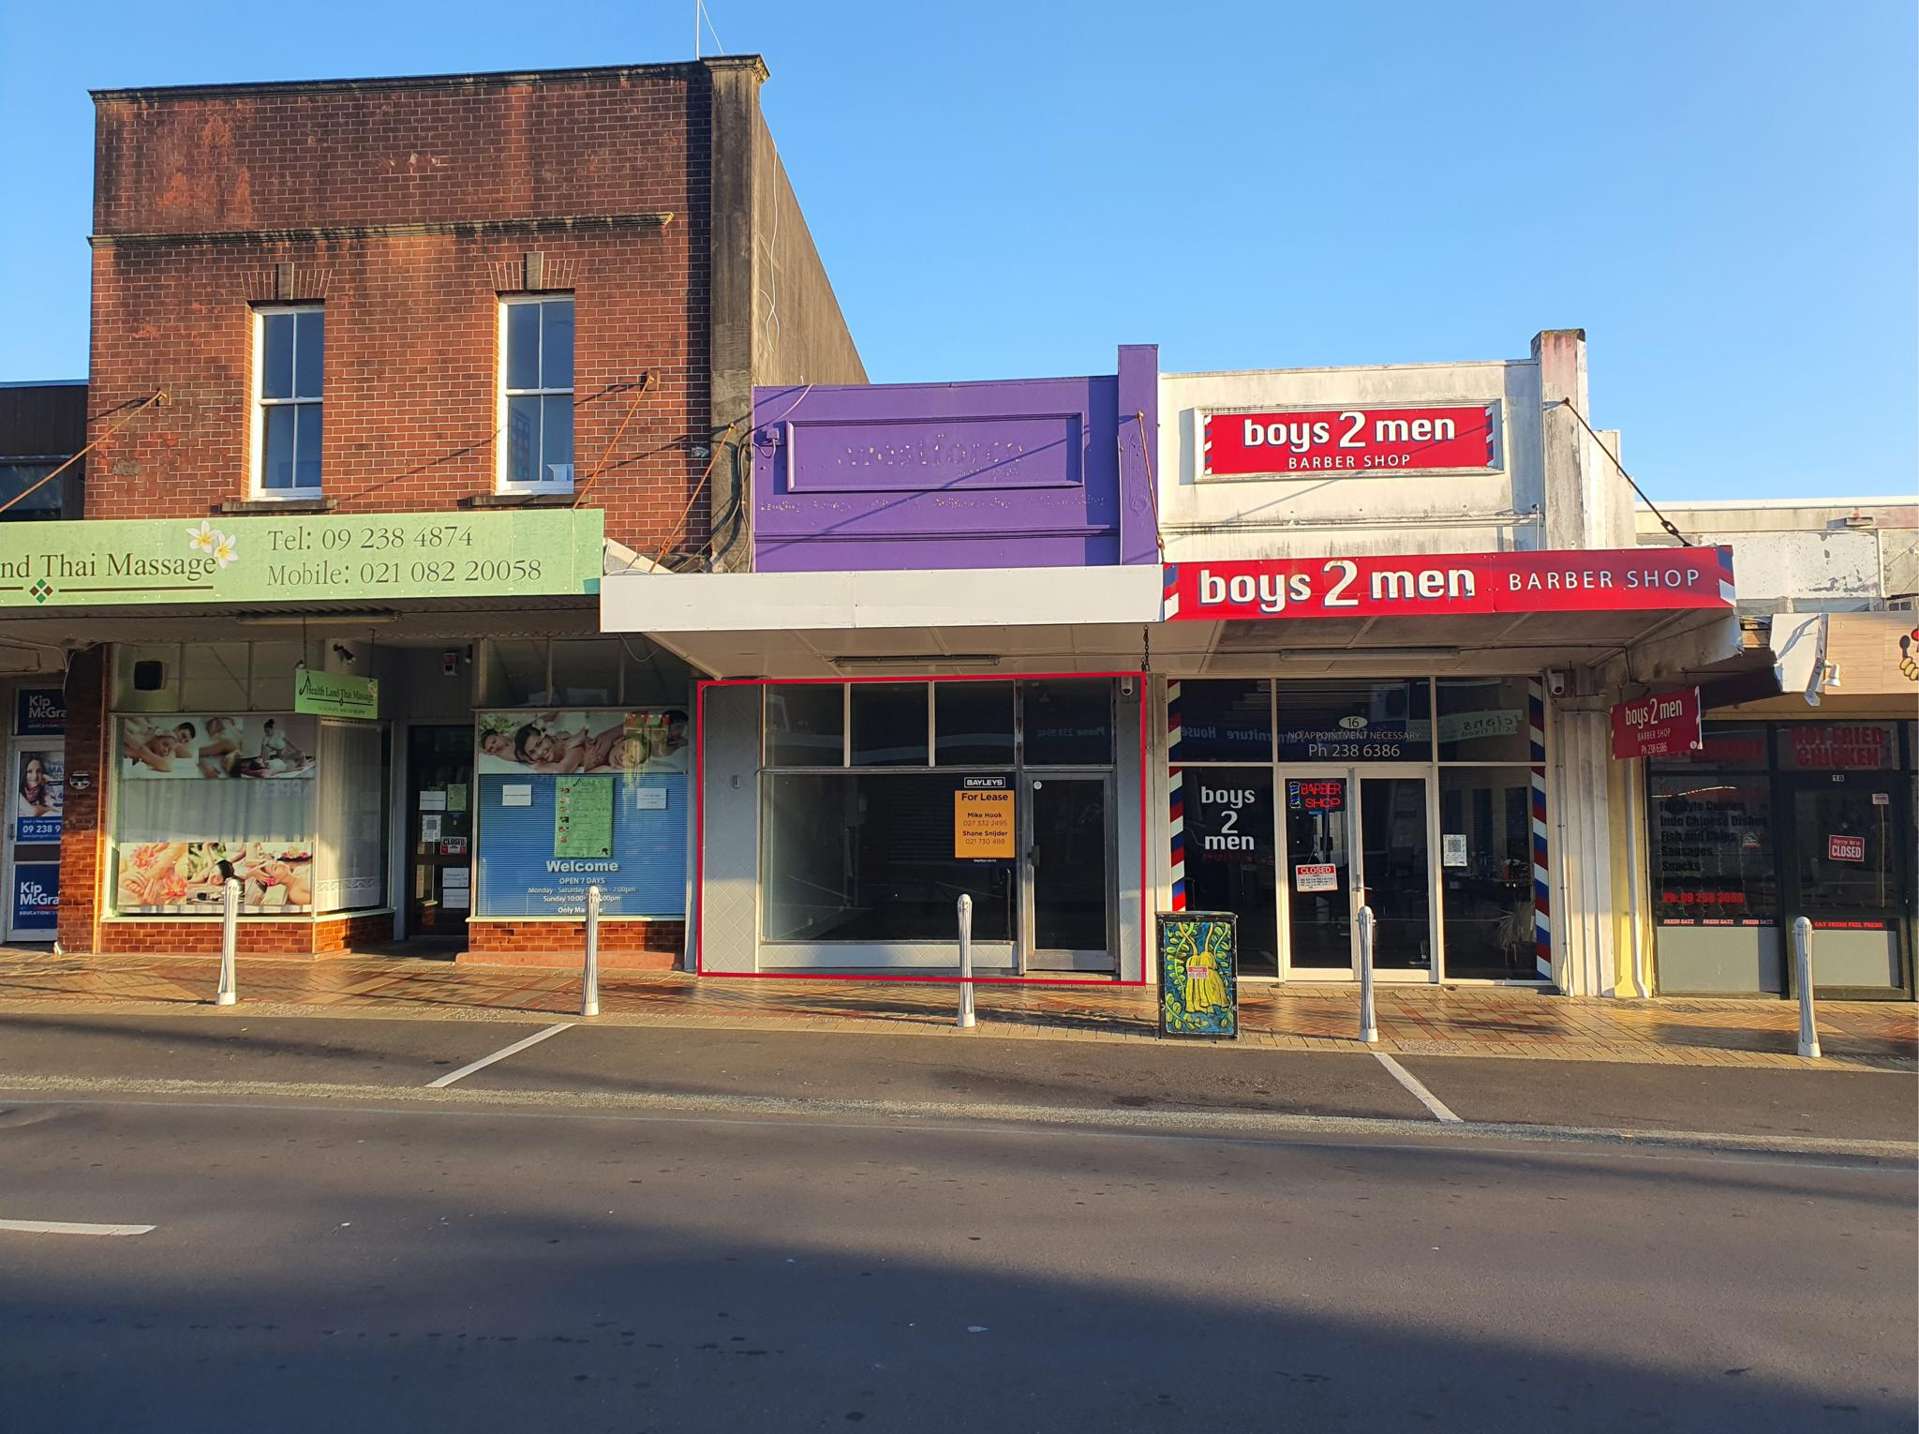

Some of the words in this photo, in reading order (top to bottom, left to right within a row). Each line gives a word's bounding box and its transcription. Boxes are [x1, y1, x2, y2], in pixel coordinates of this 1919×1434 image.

[1244, 419, 1329, 453] boys
[1339, 411, 1366, 448] 2
[1376, 418, 1455, 442] men
[1289, 456, 1355, 469] BARBER
[1364, 454, 1411, 467] SHOP
[267, 526, 311, 551] Tel:
[322, 528, 352, 551] 09
[360, 527, 405, 550] 238
[413, 525, 473, 548] 4874
[40, 552, 96, 577] Thai
[106, 552, 217, 581] Massage
[267, 560, 350, 586] Mobile:
[360, 562, 401, 583] 021
[410, 561, 456, 582] 082
[465, 559, 542, 582] 20058
[1200, 569, 1311, 613] boys
[1323, 559, 1359, 606] 2
[1371, 569, 1475, 599] men
[1509, 571, 1613, 591] BARBER
[1627, 569, 1700, 588] SHOP
[29, 695, 51, 710] Kip
[1625, 706, 1648, 729] boys
[1650, 698, 1658, 724] 2
[1660, 699, 1683, 719] men
[1346, 718, 1359, 727] 16
[1304, 731, 1367, 740] APPOINTMENT
[1370, 731, 1420, 740] NECESSARY
[1657, 728, 1671, 738] SHOP
[1309, 744, 1327, 757] Ph
[1332, 744, 1359, 757] 238
[1363, 744, 1400, 757] 6386
[1301, 783, 1341, 795] BARBER
[961, 793, 978, 801] For
[980, 793, 1008, 801] Lease
[1201, 785, 1255, 808] boys
[1305, 798, 1341, 808] SHOP
[22, 825, 34, 833] 09
[1221, 811, 1238, 834] 2
[1205, 836, 1254, 850] men
[1831, 845, 1861, 858] CLOSED
[546, 860, 619, 873] Welcome
[20, 881, 42, 897] Kip
[528, 887, 553, 895] Monday
[543, 895, 566, 903] Sunday
[558, 906, 573, 914] Only
